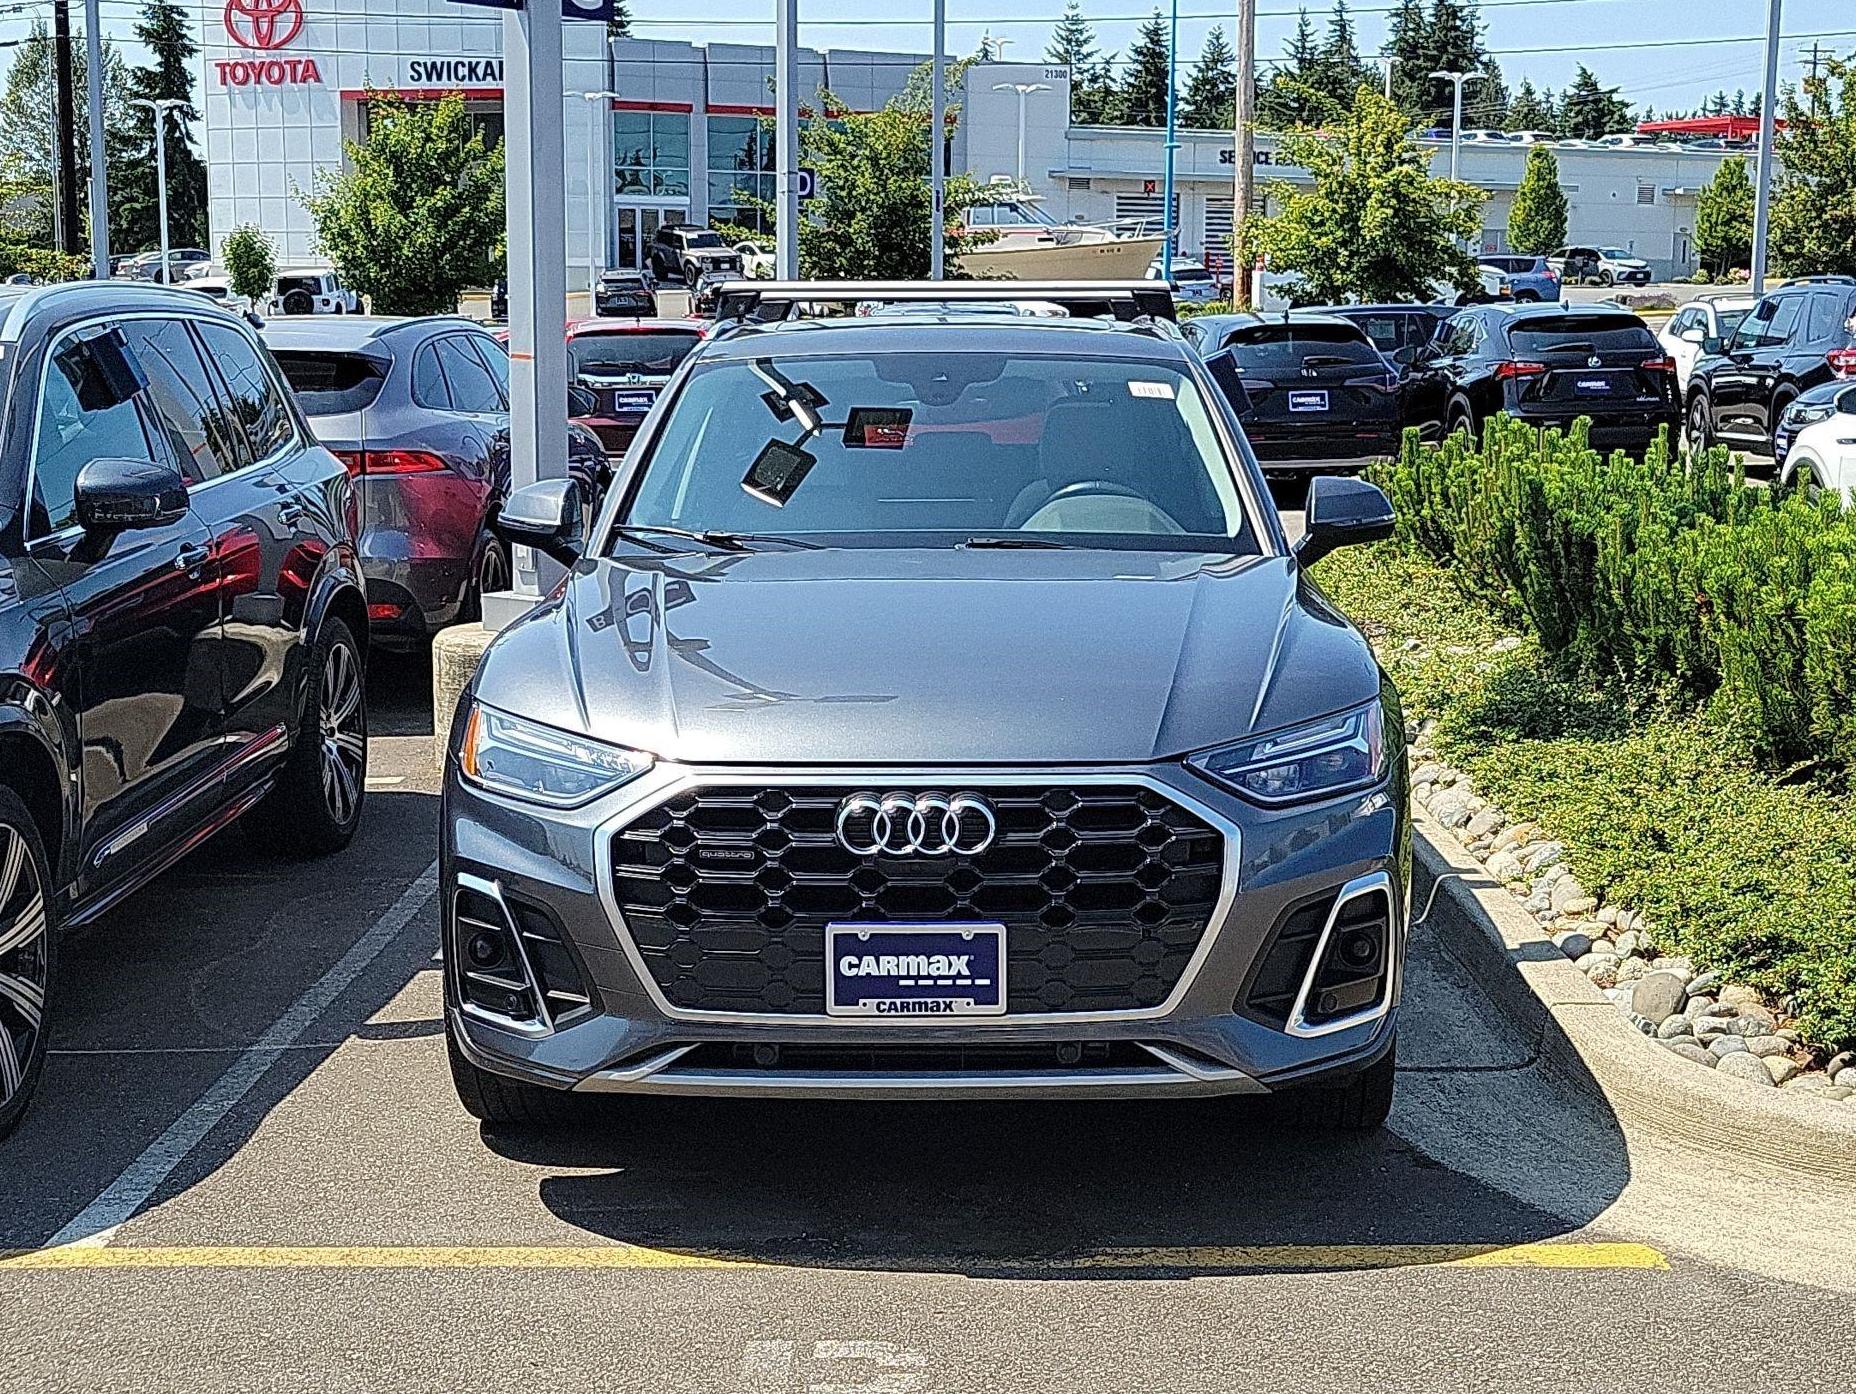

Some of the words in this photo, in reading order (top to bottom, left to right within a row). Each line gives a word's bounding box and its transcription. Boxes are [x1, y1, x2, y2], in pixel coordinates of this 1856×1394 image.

[215, 59, 321, 86] TOYOTA
[1045, 70, 1067, 79] 21300
[1219, 150, 1272, 166] SEICE
[702, 851, 752, 859] quattro
